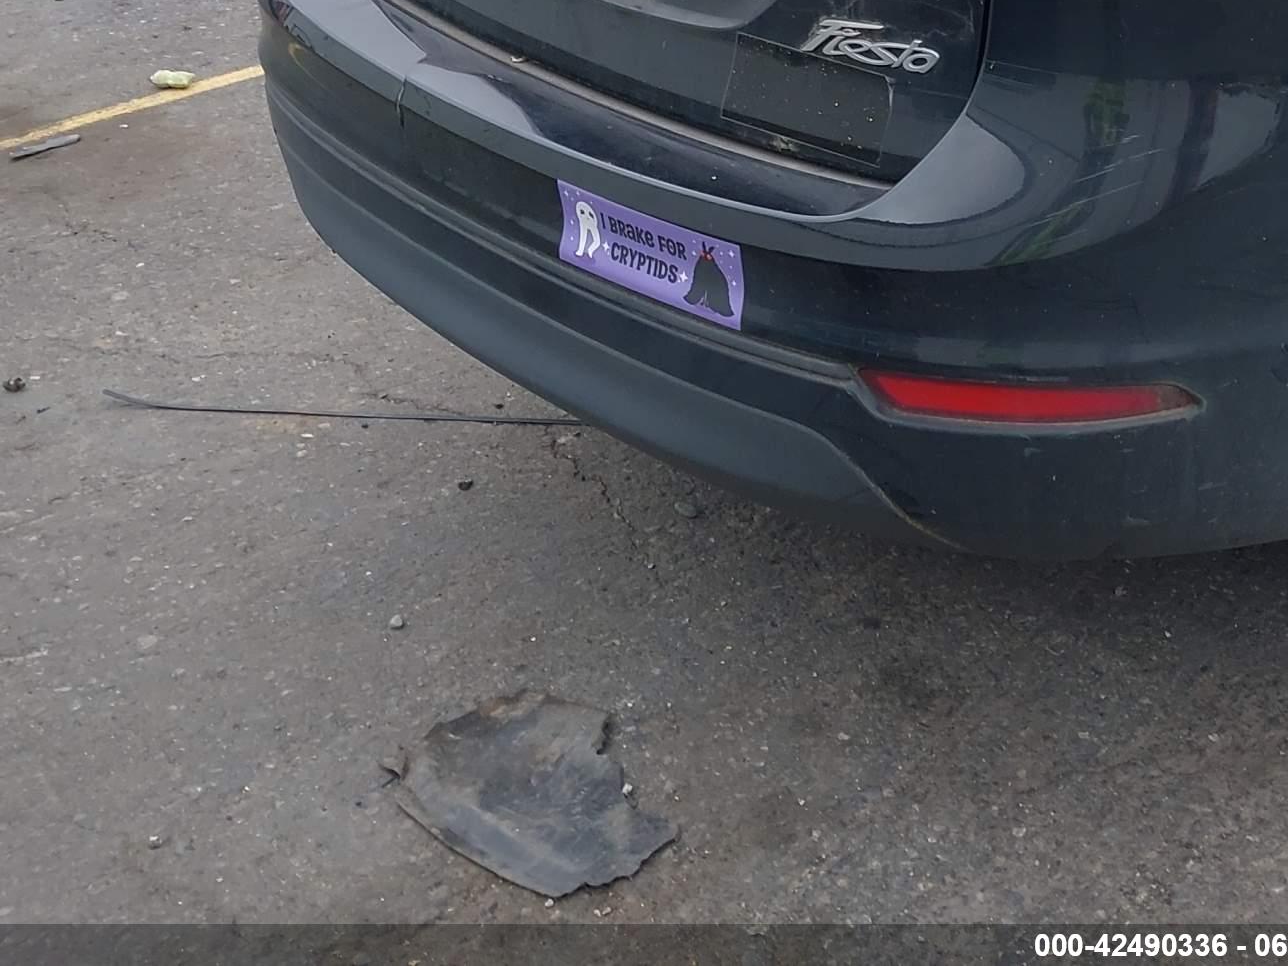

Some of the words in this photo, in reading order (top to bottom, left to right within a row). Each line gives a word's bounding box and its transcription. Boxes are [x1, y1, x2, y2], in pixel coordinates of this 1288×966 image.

[801, 19, 940, 74] Fiesta
[600, 212, 606, 230] I
[657, 235, 687, 261] FOR
[611, 242, 679, 284] CRYPTIDS
